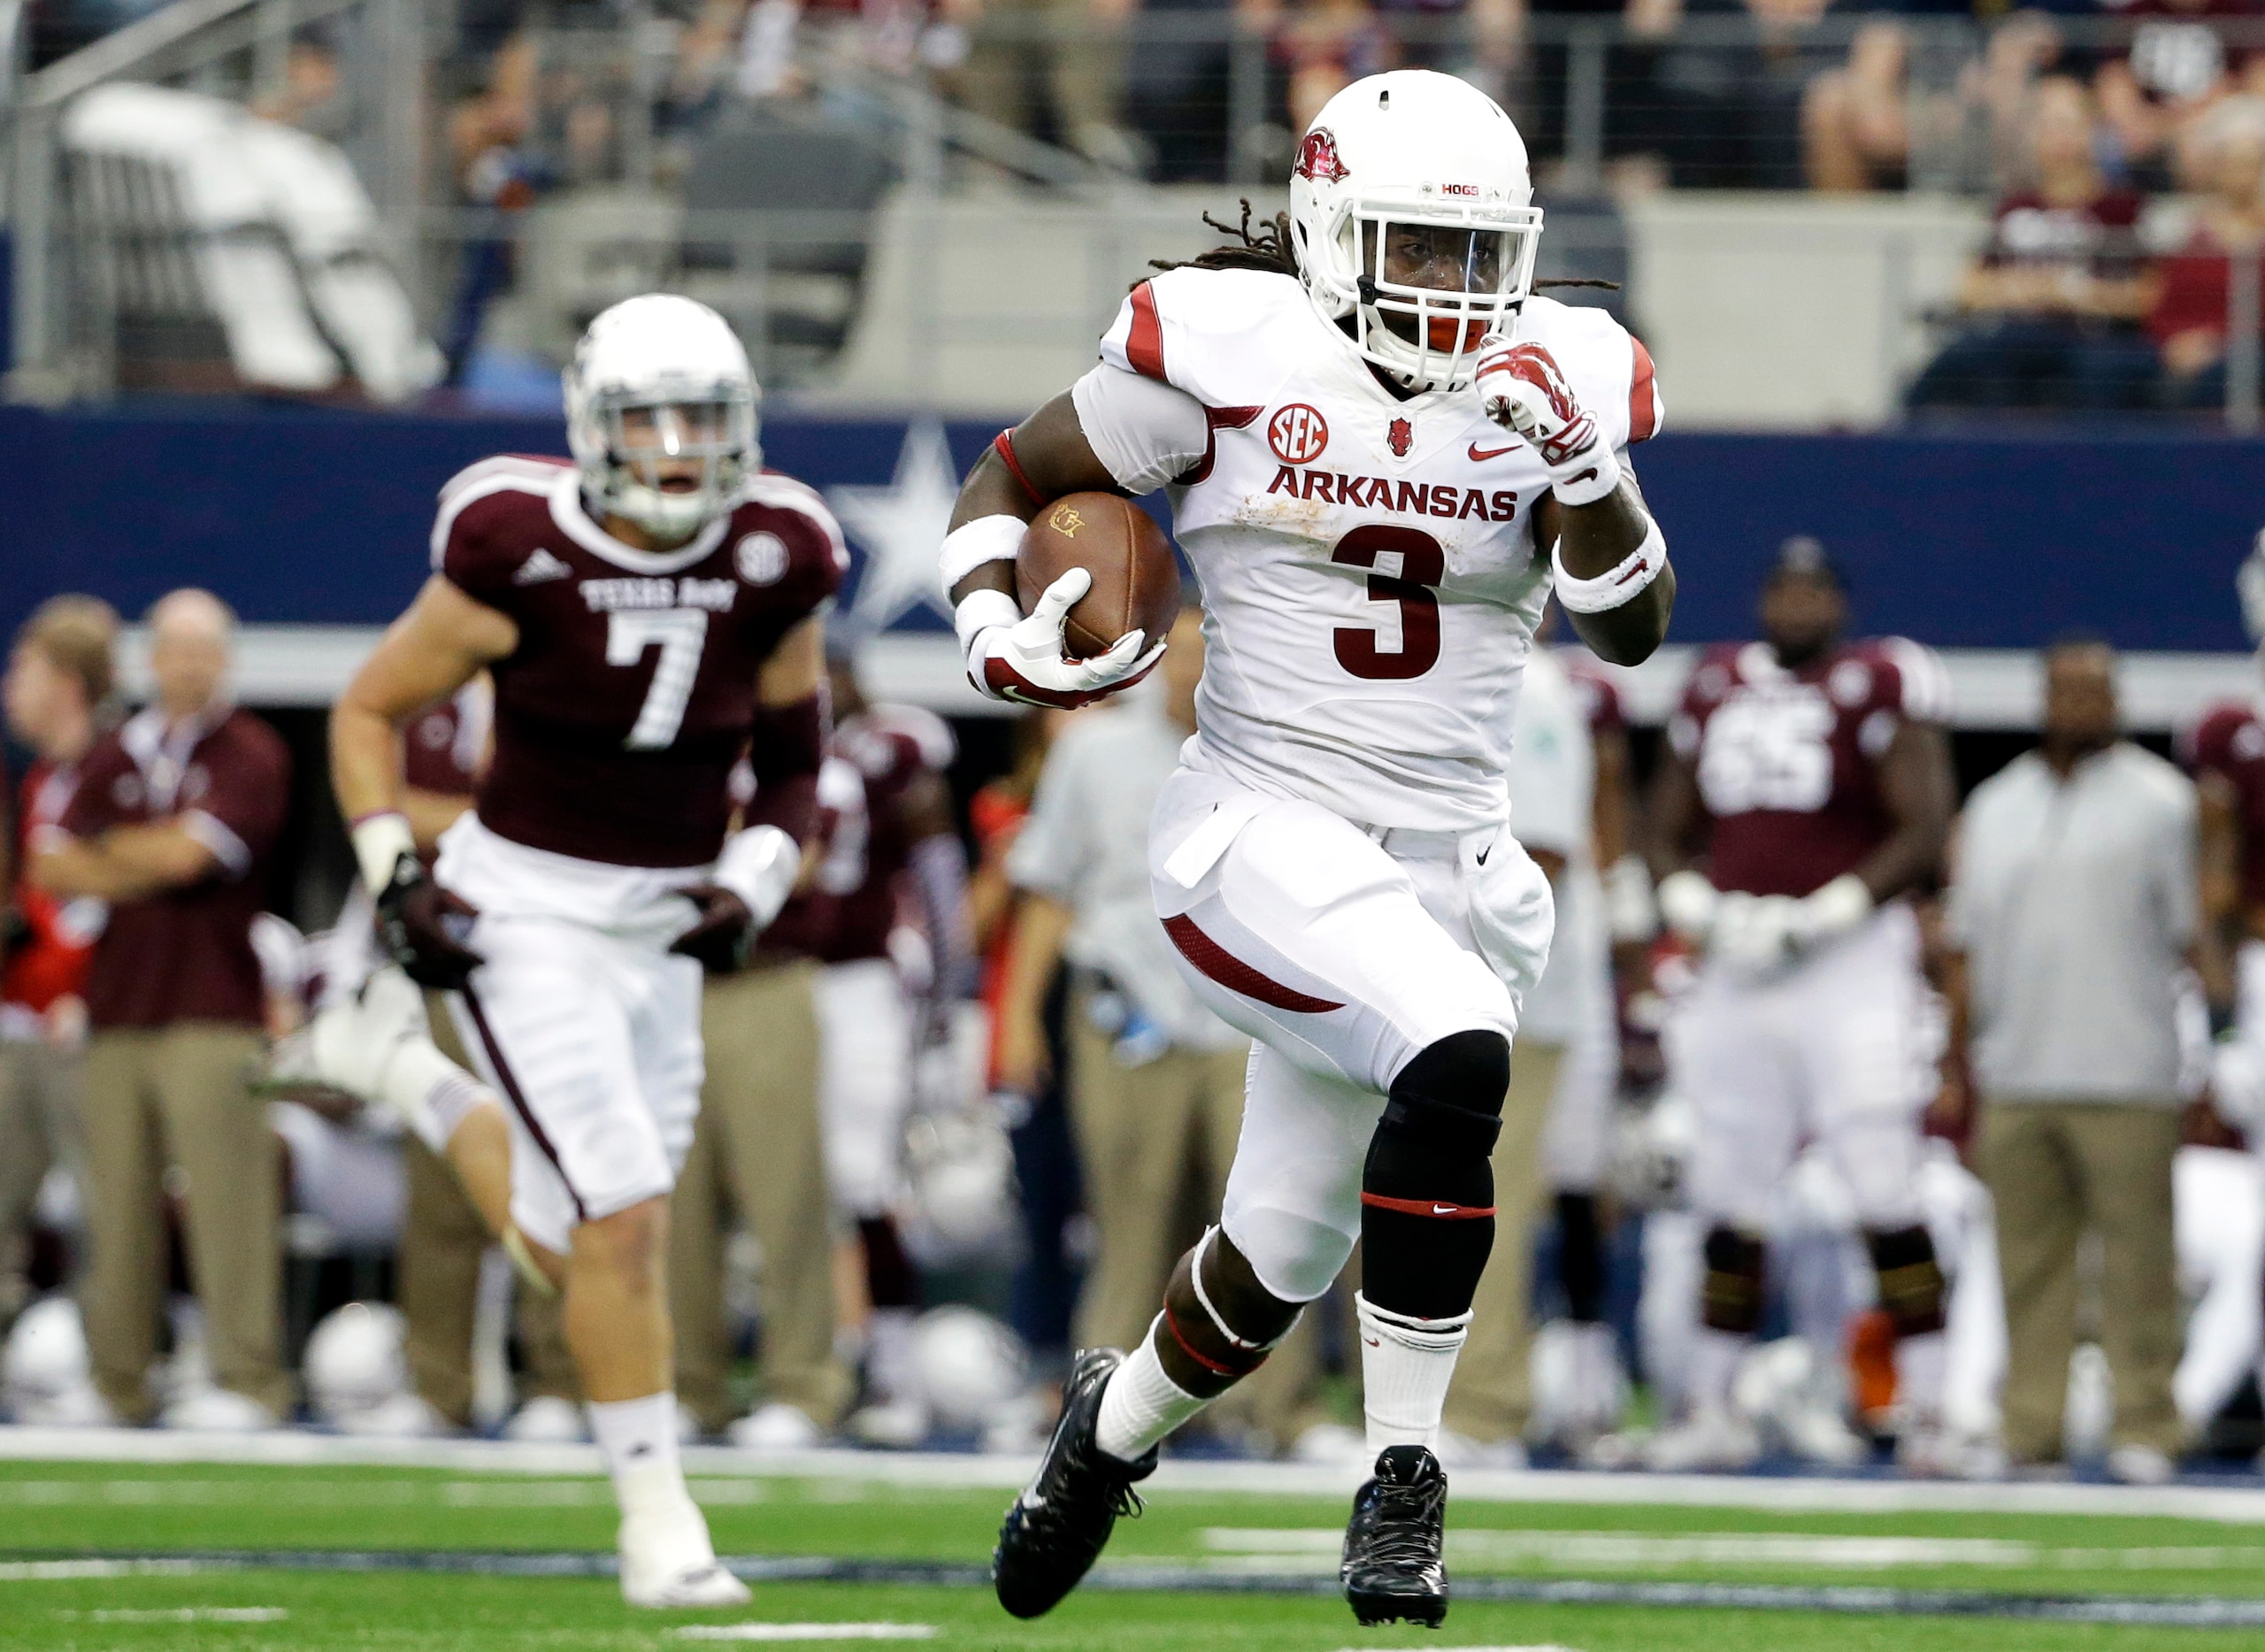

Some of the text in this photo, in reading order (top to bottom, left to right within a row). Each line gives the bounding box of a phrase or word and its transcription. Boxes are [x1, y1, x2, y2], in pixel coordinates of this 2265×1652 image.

[1442, 183, 1478, 196] HOGS
[1272, 406, 1326, 460] SEC
[1267, 465, 1518, 522] ARKANSAS
[579, 577, 675, 612] TEXAS
[1331, 524, 1445, 679] 3
[605, 607, 709, 750] 7
